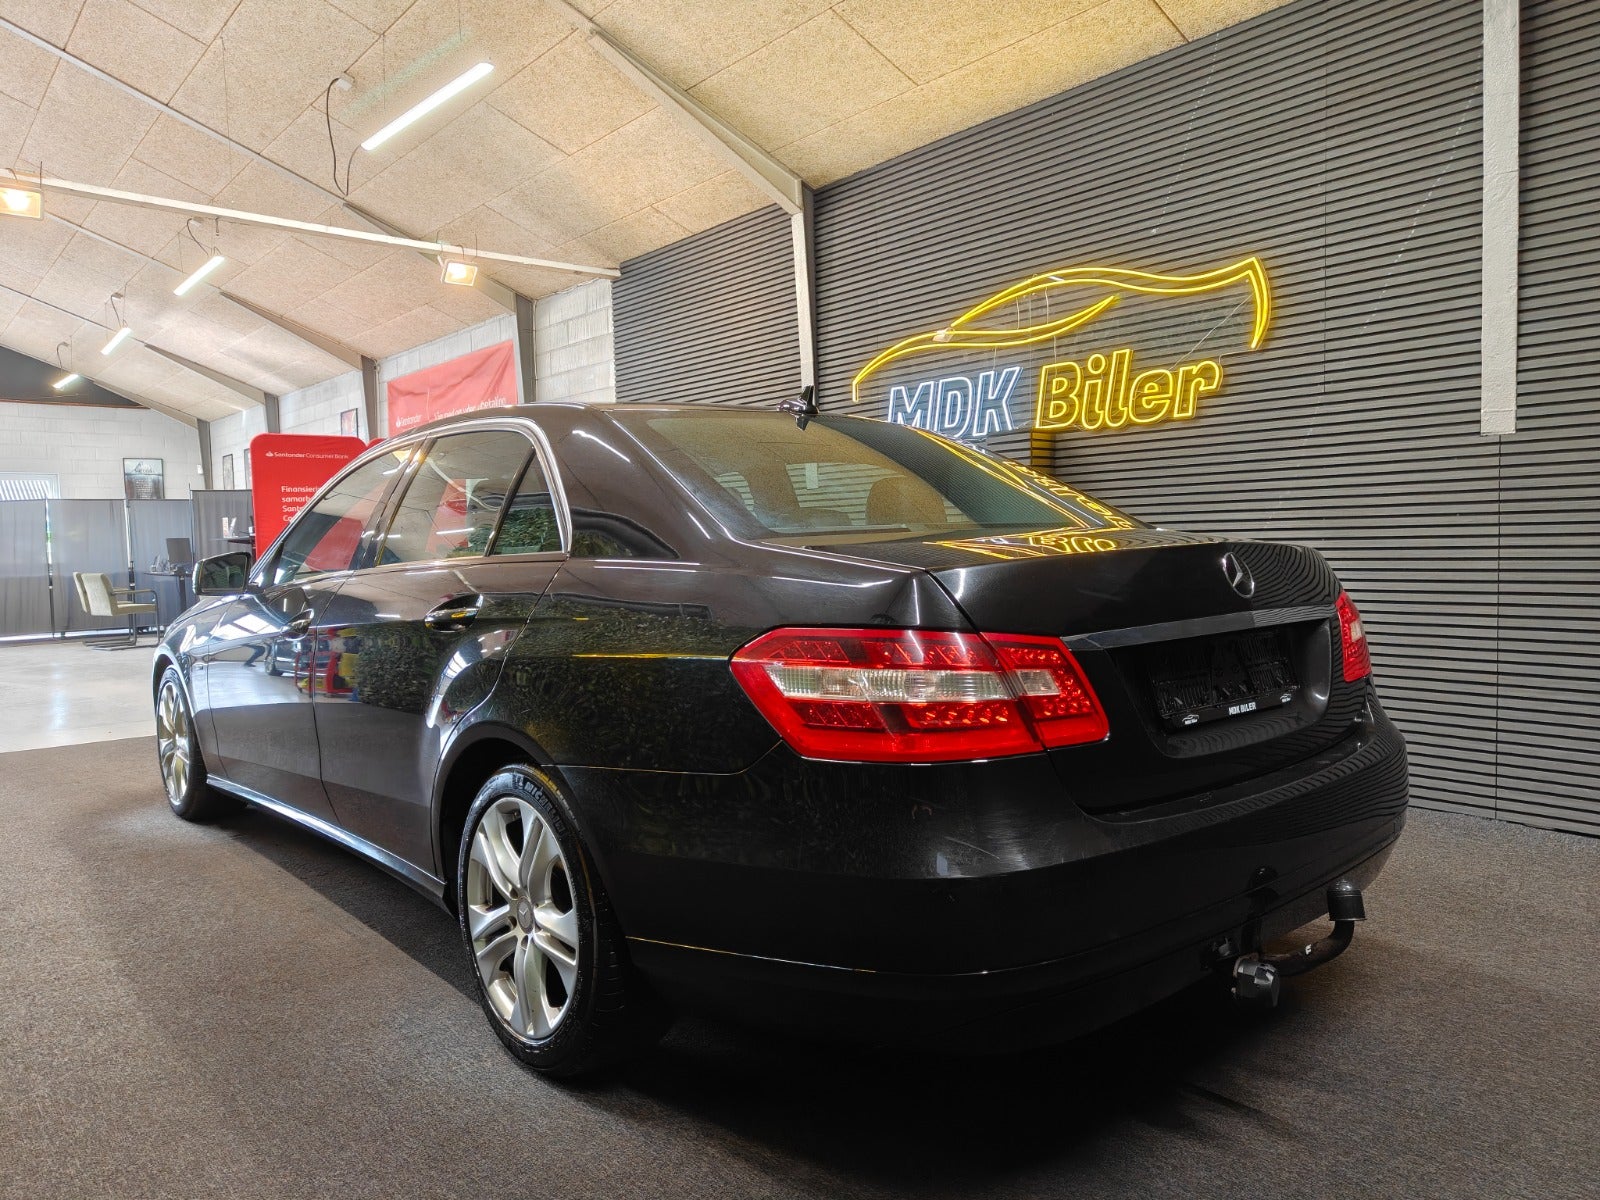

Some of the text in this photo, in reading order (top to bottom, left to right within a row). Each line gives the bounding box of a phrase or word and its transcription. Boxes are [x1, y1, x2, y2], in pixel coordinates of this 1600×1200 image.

[888, 348, 1222, 438] MDK Biler
[281, 495, 311, 503] samarb
[1228, 702, 1257, 715] MDK BILER
